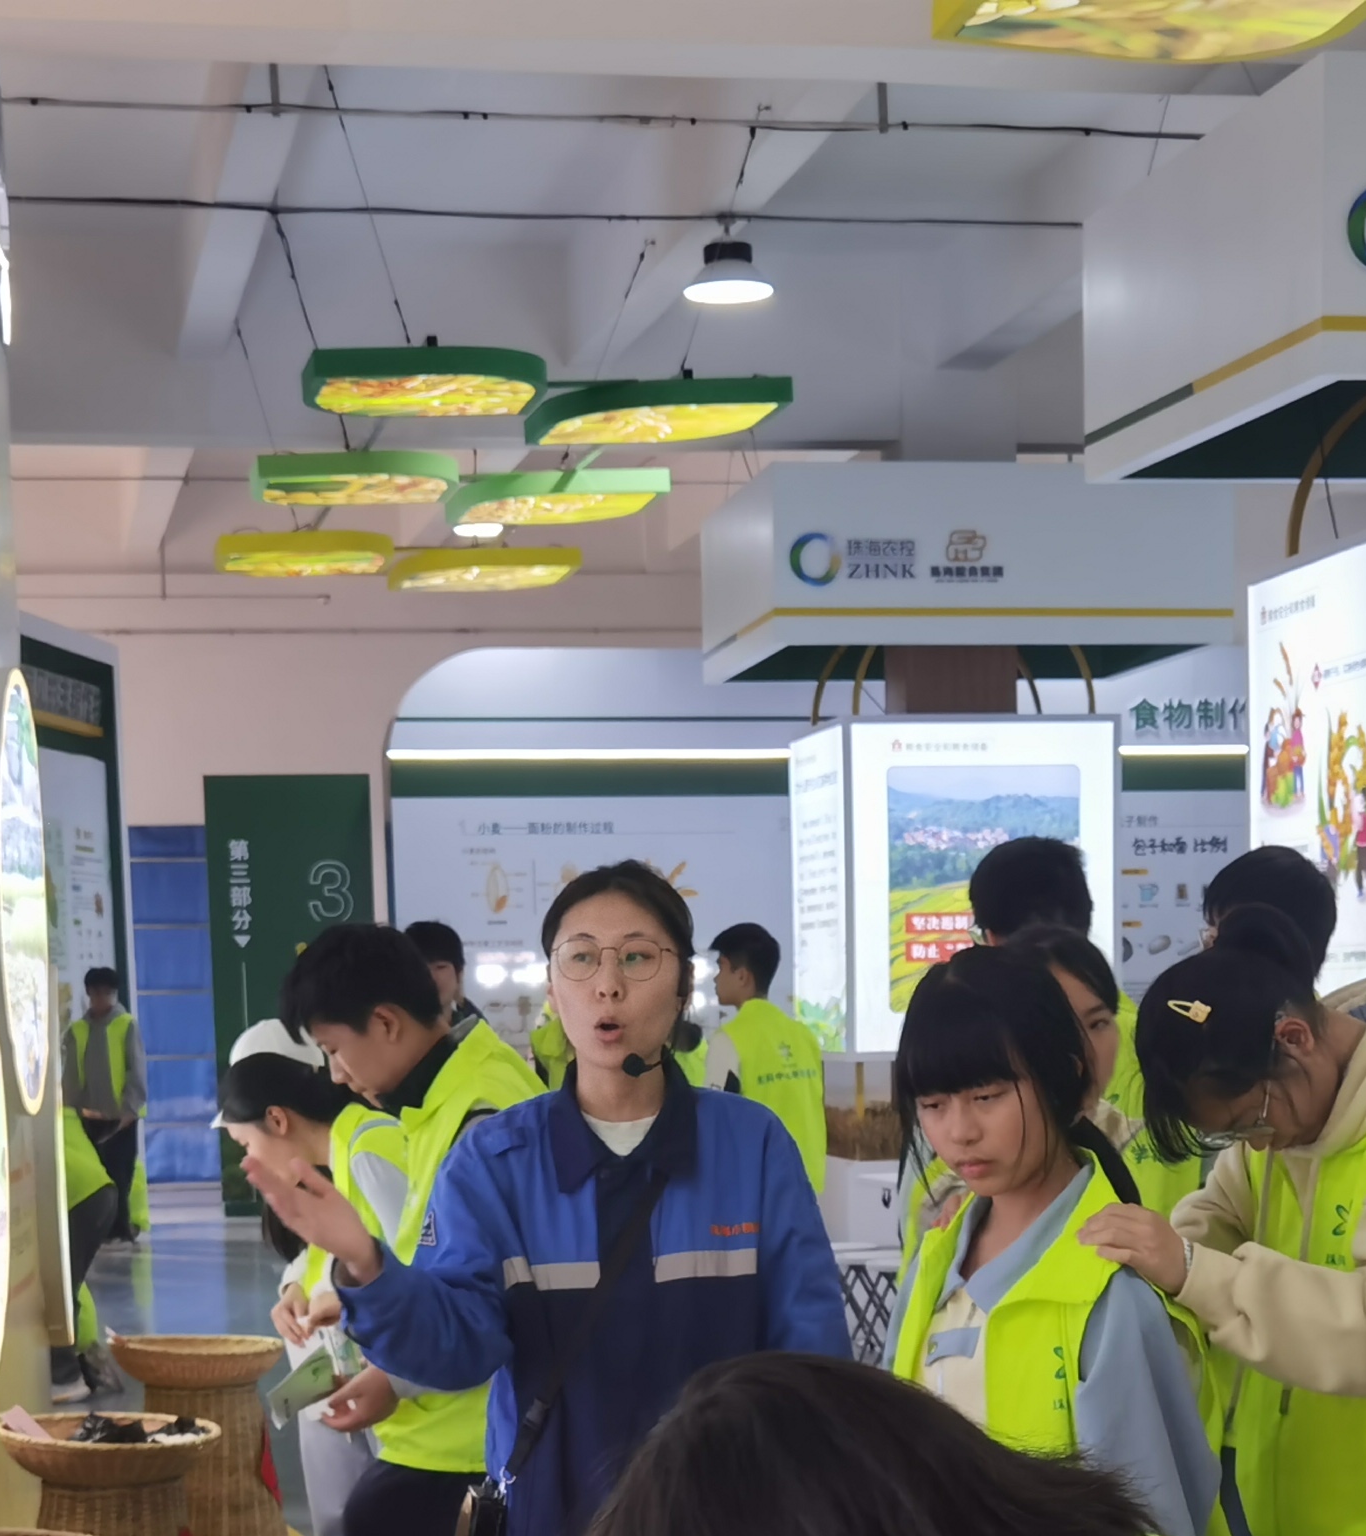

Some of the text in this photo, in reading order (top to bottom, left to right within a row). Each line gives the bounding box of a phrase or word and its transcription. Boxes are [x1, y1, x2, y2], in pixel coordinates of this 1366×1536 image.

[847, 539, 916, 557] 珠海农控
[847, 563, 917, 579] ZHNK
[227, 838, 254, 931] 第三部分
[307, 858, 355, 923] 3
